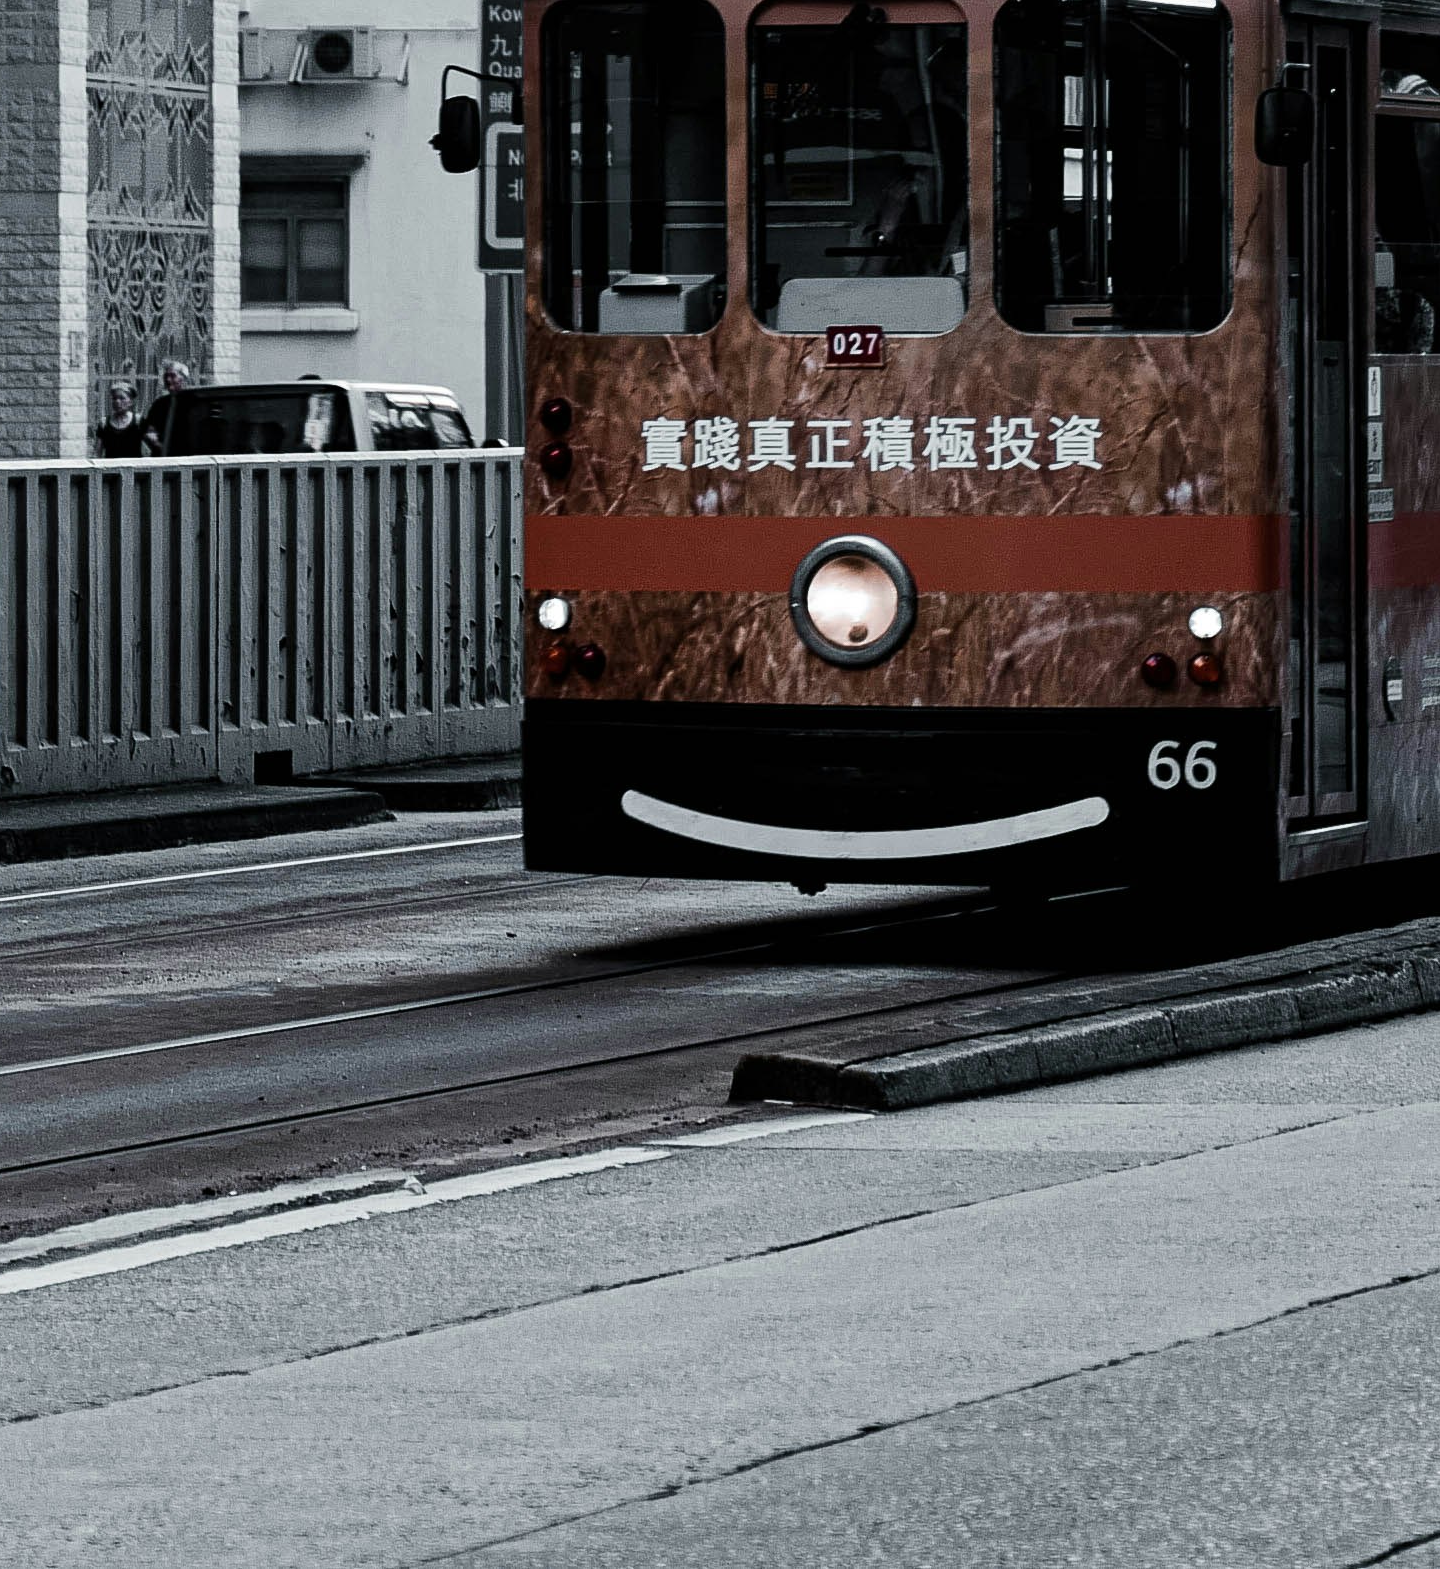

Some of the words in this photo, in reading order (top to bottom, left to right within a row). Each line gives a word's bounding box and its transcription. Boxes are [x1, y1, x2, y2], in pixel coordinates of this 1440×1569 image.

[833, 332, 879, 355] 027
[640, 415, 1103, 472] 實踐真正積極投資
[1147, 739, 1217, 790] 66
